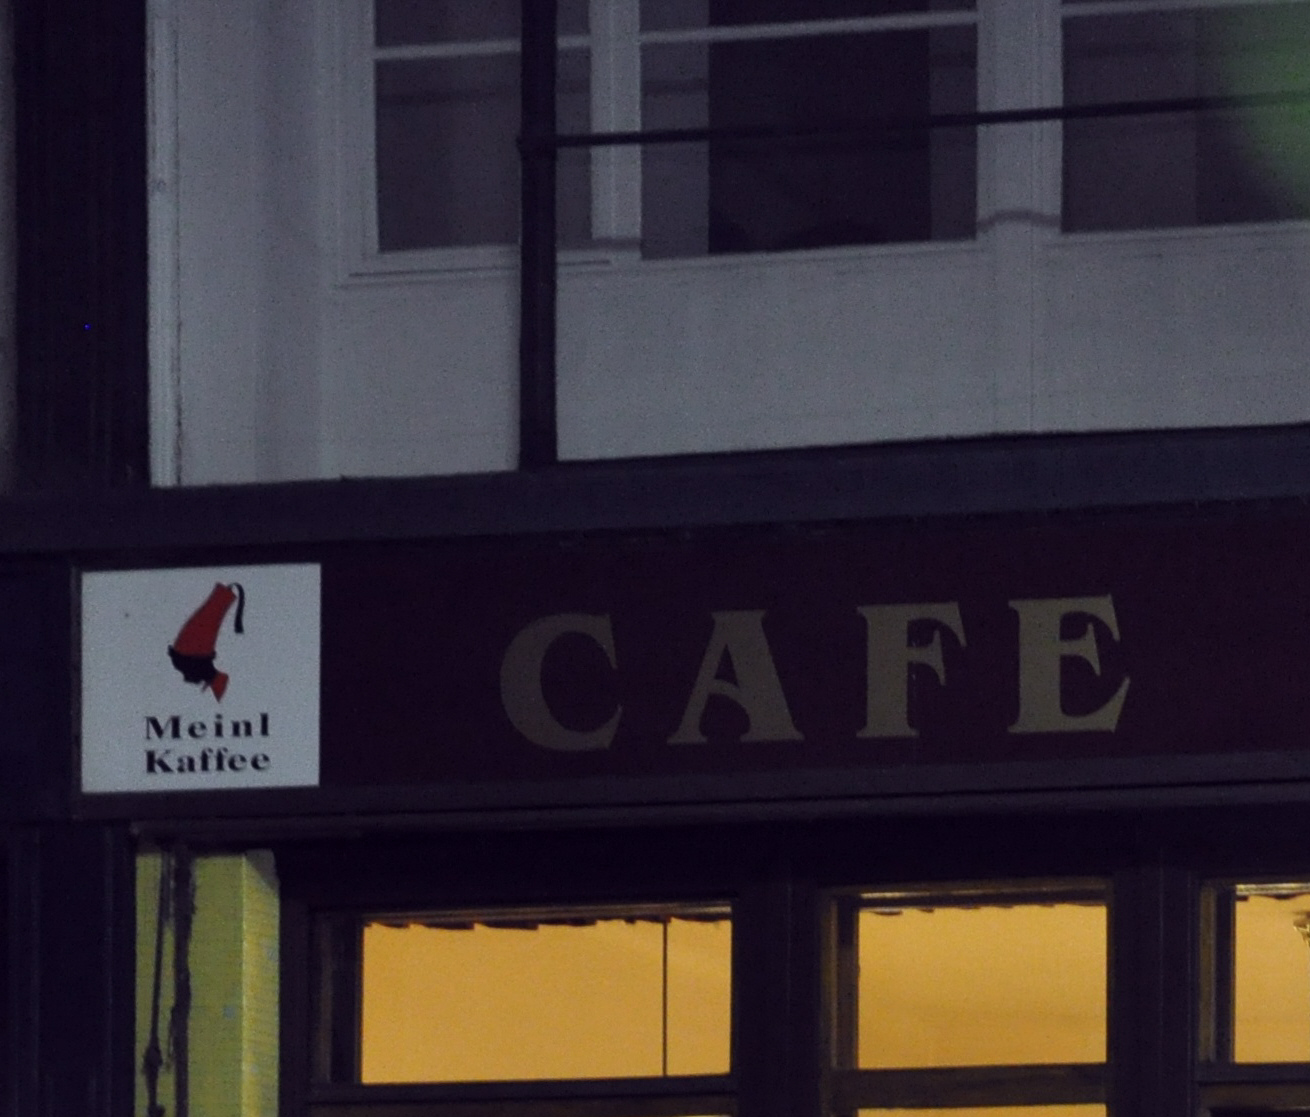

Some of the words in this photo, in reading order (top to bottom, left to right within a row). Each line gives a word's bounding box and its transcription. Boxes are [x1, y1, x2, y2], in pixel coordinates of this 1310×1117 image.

[500, 594, 1131, 752] CAFE
[145, 712, 270, 740] Meinl
[145, 746, 271, 775] Kaffee
